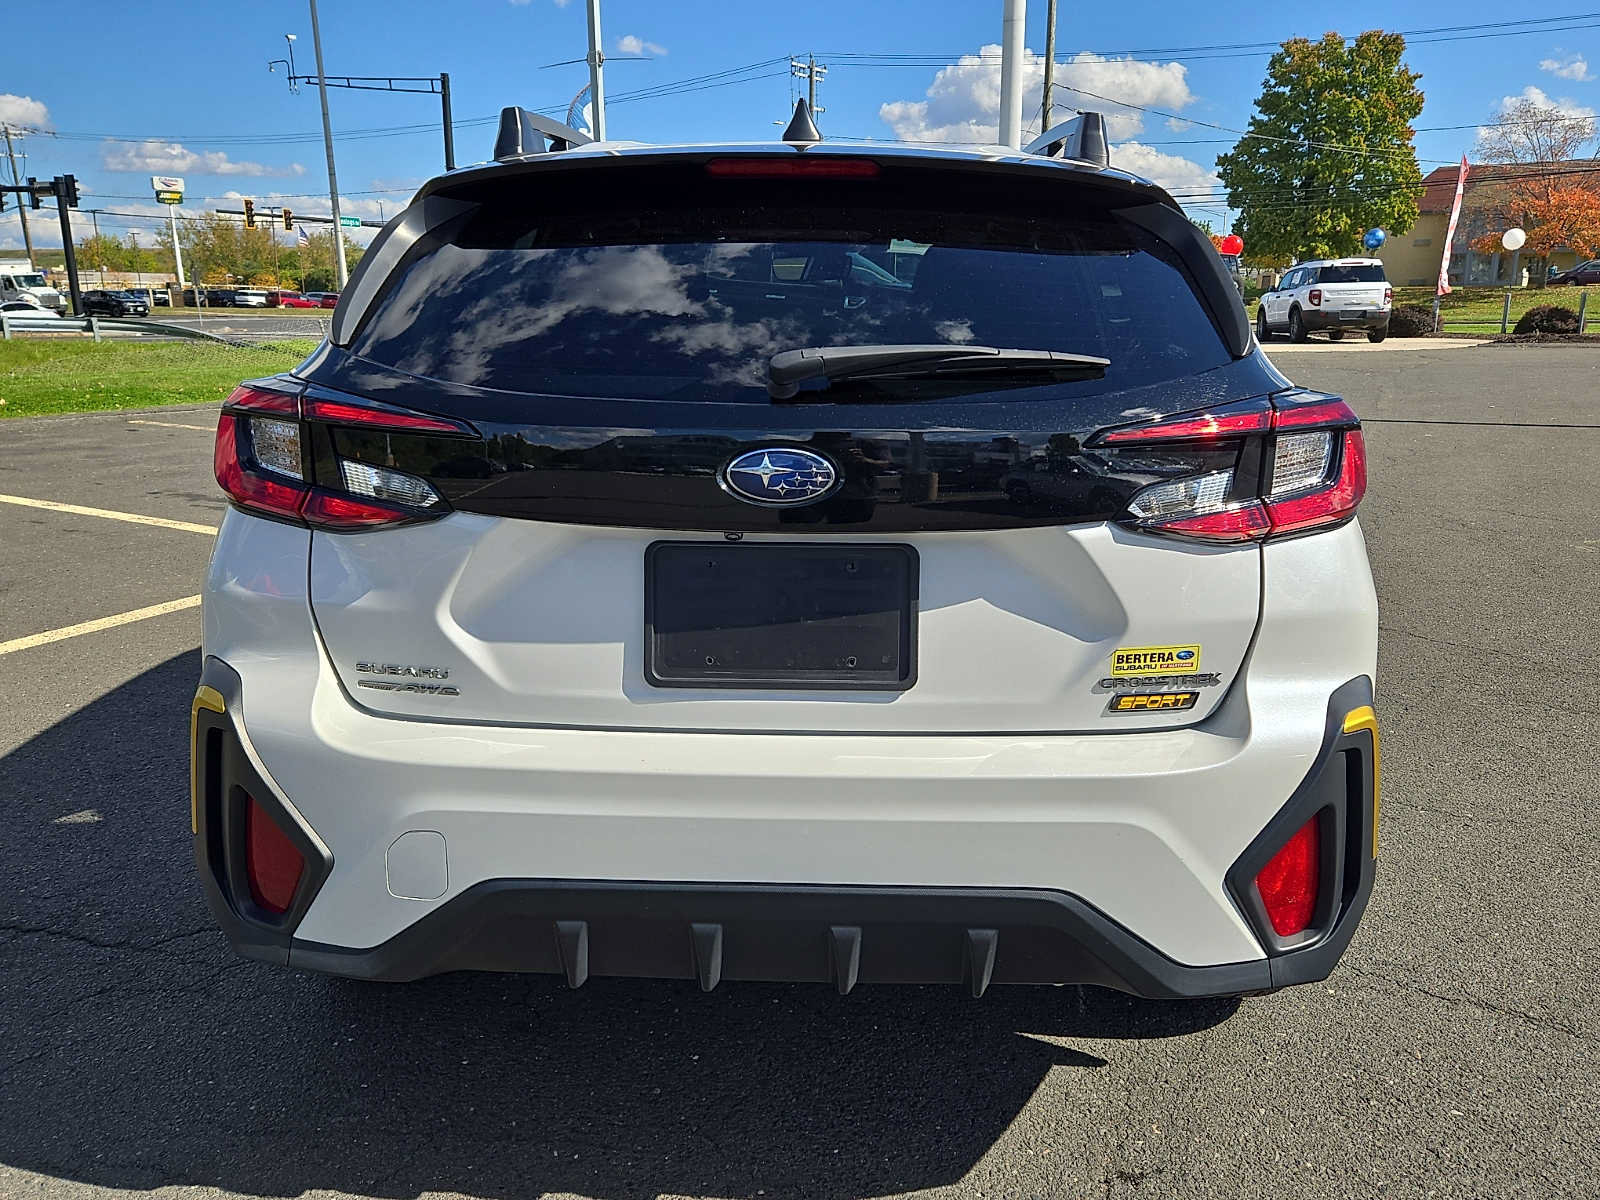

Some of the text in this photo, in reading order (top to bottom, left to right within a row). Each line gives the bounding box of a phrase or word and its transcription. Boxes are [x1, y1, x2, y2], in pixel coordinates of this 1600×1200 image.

[1116, 652, 1174, 665] BERTERA
[356, 663, 449, 679] SUBARU
[1100, 673, 1222, 689] CROSSTREK
[1118, 694, 1191, 709] SPORT
